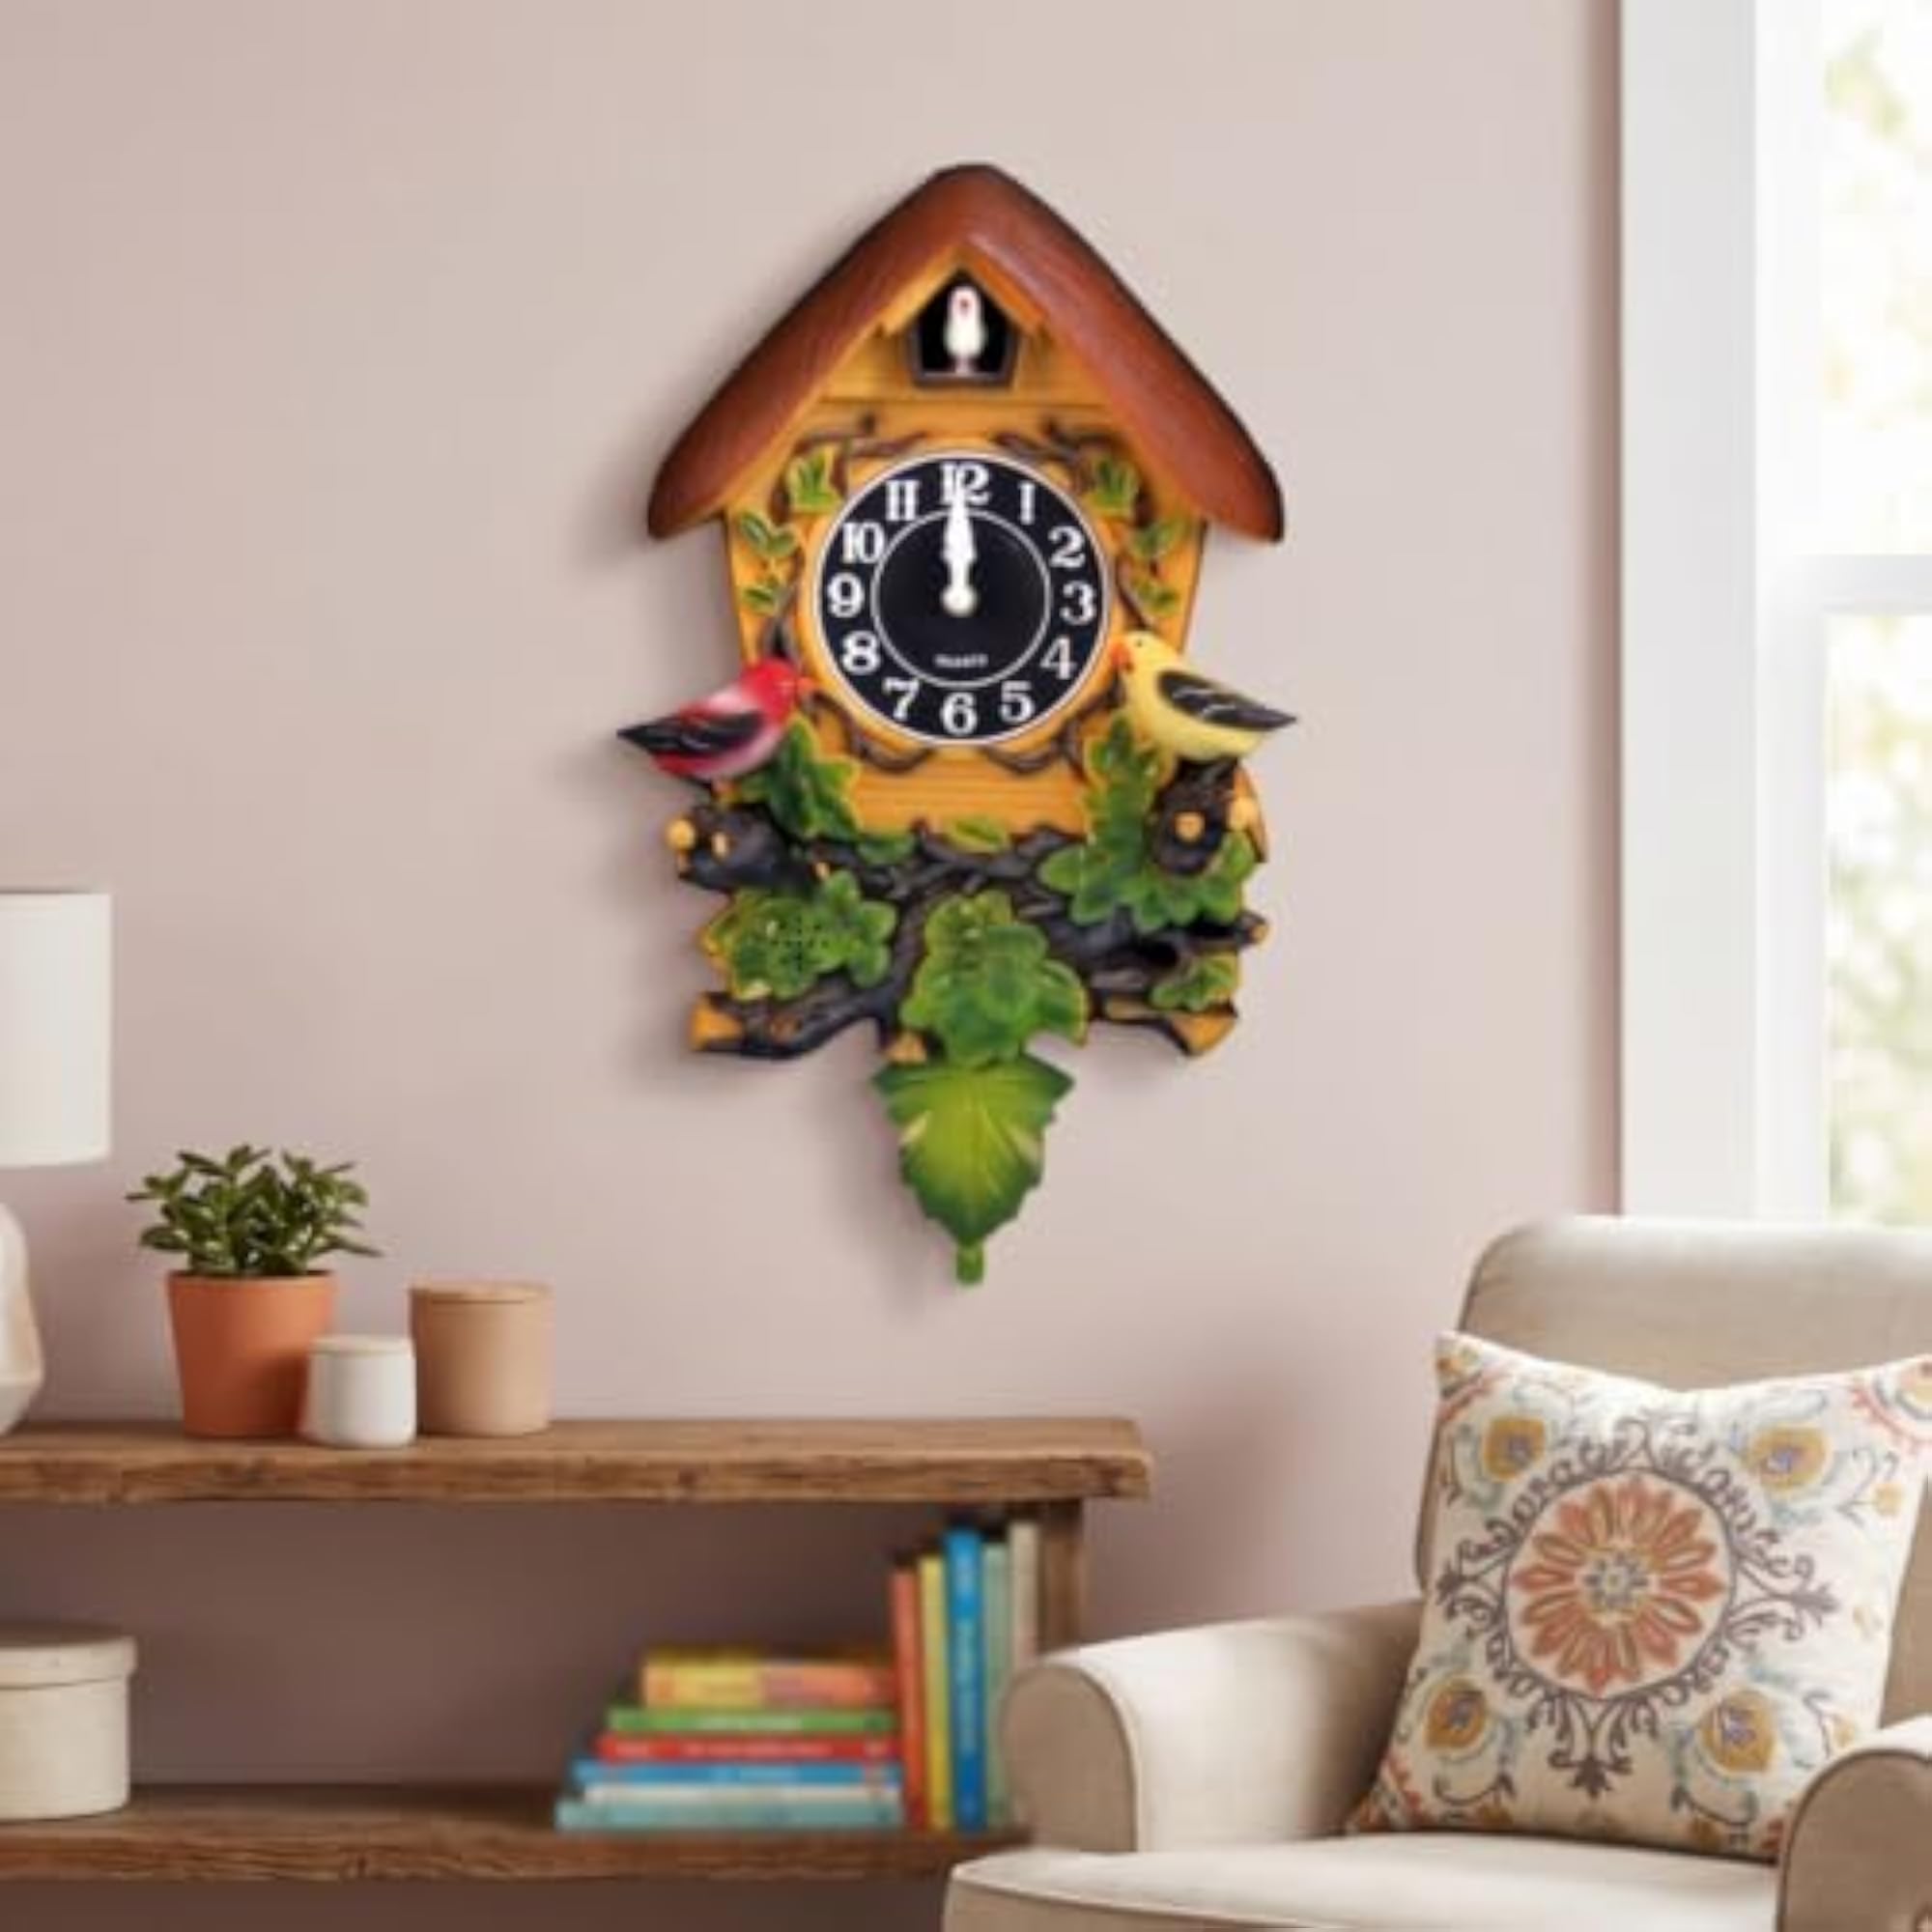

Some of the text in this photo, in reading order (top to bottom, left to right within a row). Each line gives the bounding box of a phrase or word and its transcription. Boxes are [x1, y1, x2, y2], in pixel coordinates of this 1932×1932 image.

[887, 480, 920, 521] 11
[941, 464, 990, 505] 12
[1018, 483, 1035, 525] 1
[842, 523, 886, 563] 10
[1048, 526, 1086, 568] 2
[828, 573, 865, 617] 9
[1059, 581, 1095, 624] 3
[841, 631, 880, 674] 8
[1041, 638, 1077, 679] 4
[883, 677, 920, 720] 7
[941, 692, 977, 734] 6
[1000, 681, 1034, 723] 5
